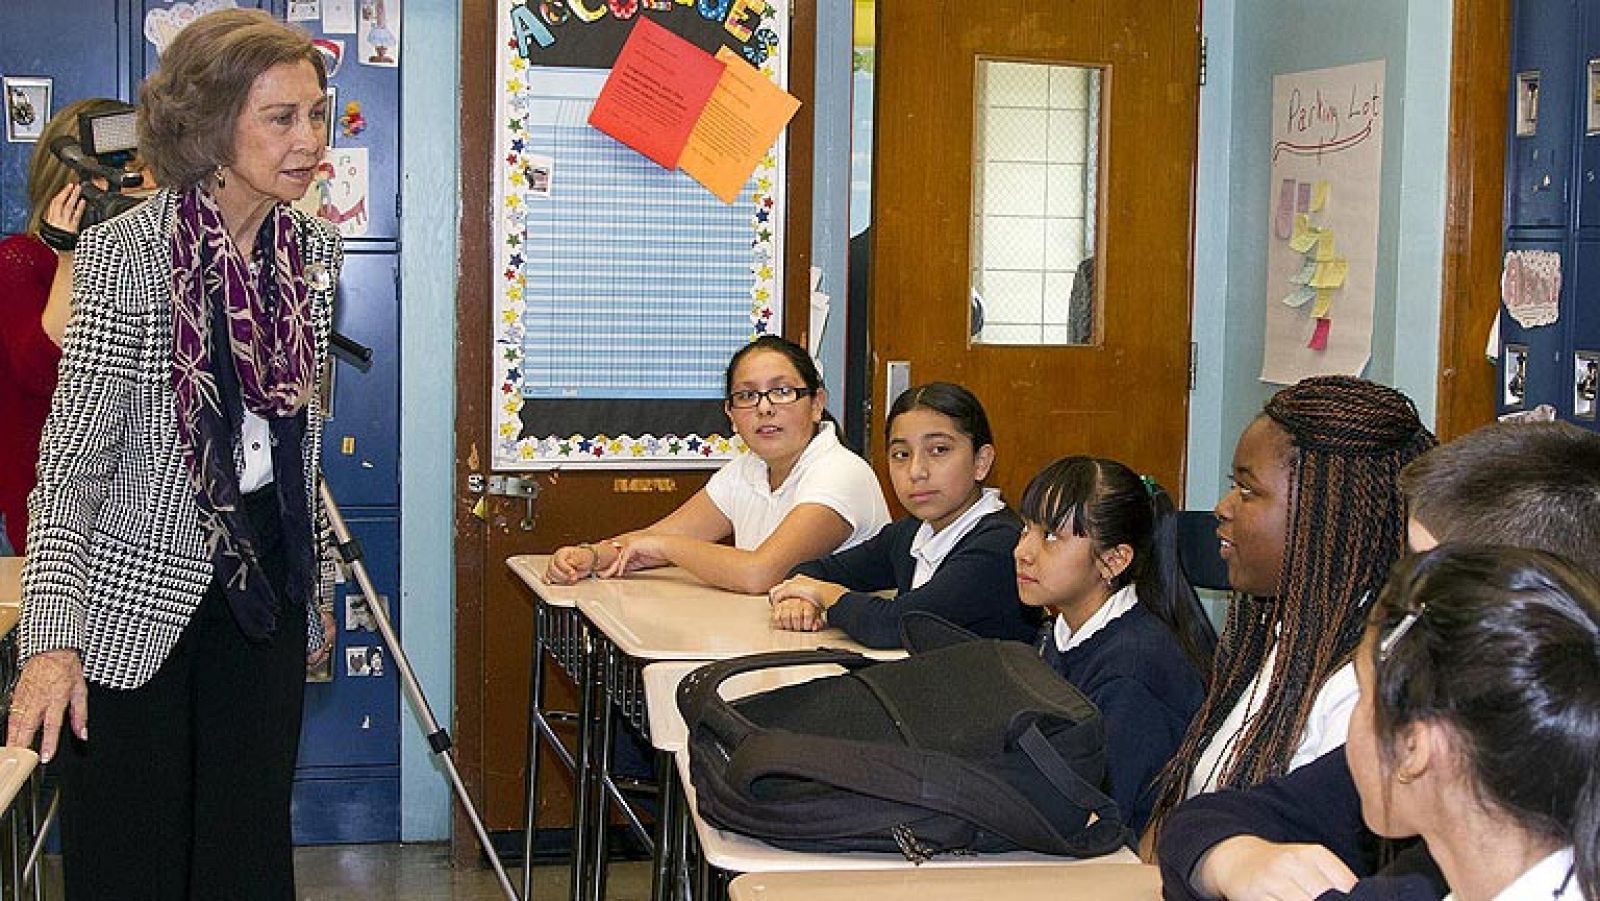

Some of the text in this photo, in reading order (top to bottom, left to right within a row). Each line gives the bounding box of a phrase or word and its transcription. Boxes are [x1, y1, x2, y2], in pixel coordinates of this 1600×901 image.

[511, 0, 779, 65] ACCODES
[1287, 83, 1380, 142] Parking Lot
